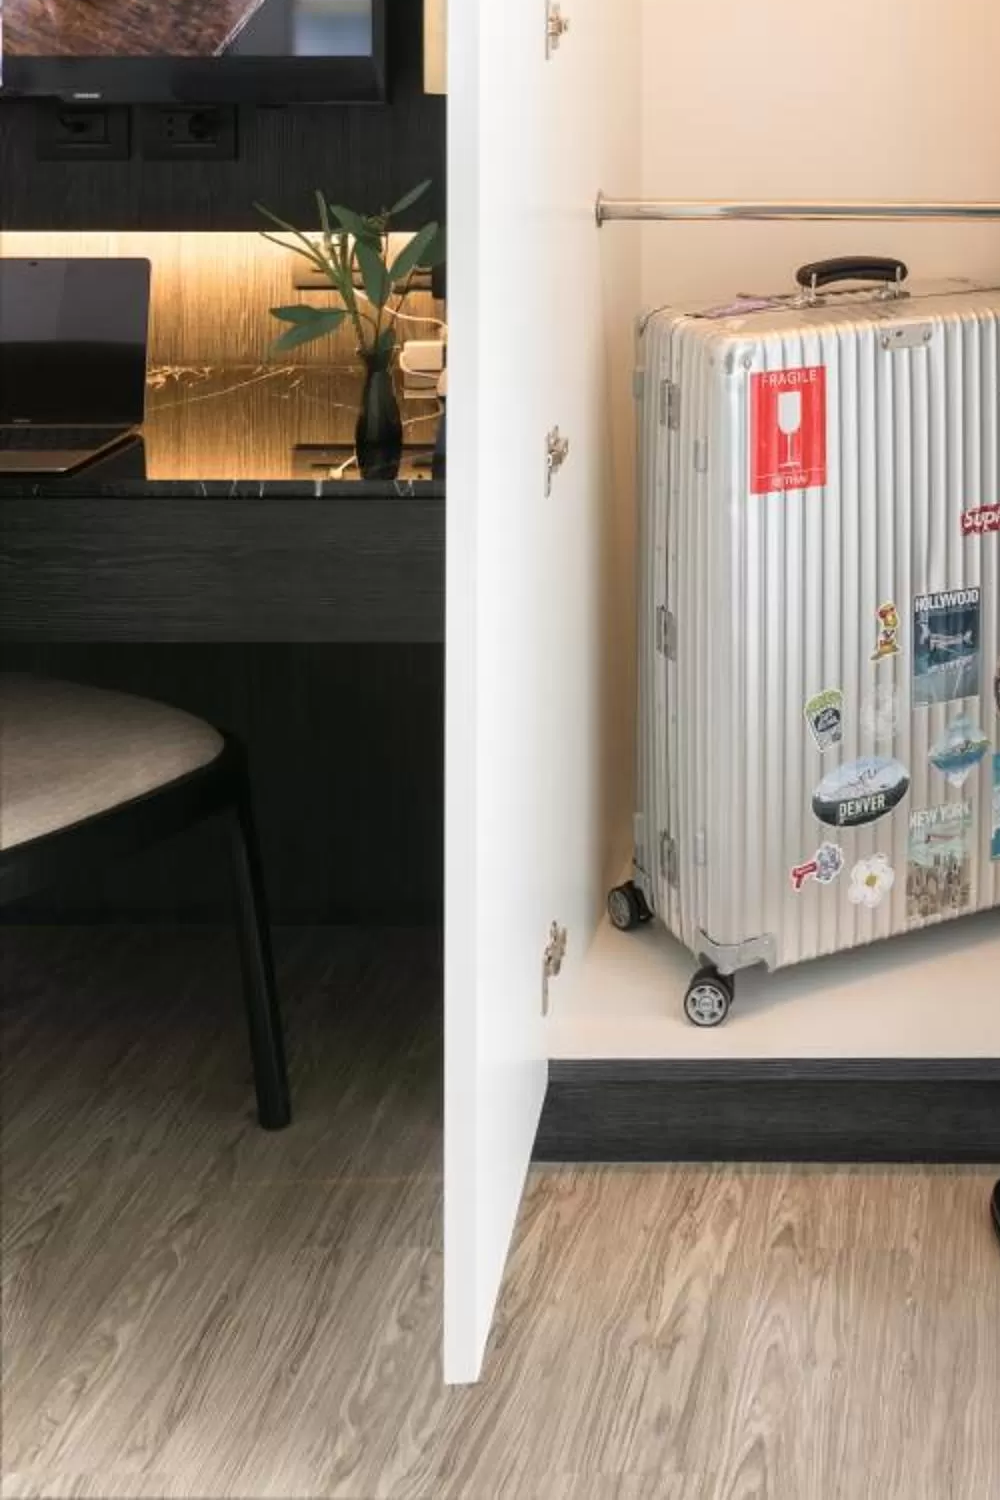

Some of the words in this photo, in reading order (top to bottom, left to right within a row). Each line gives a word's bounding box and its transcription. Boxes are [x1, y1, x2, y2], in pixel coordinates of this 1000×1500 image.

[761, 369, 817, 389] FRAGILE
[915, 589, 979, 612] HOLLYWOOD
[840, 794, 885, 817] DENVER
